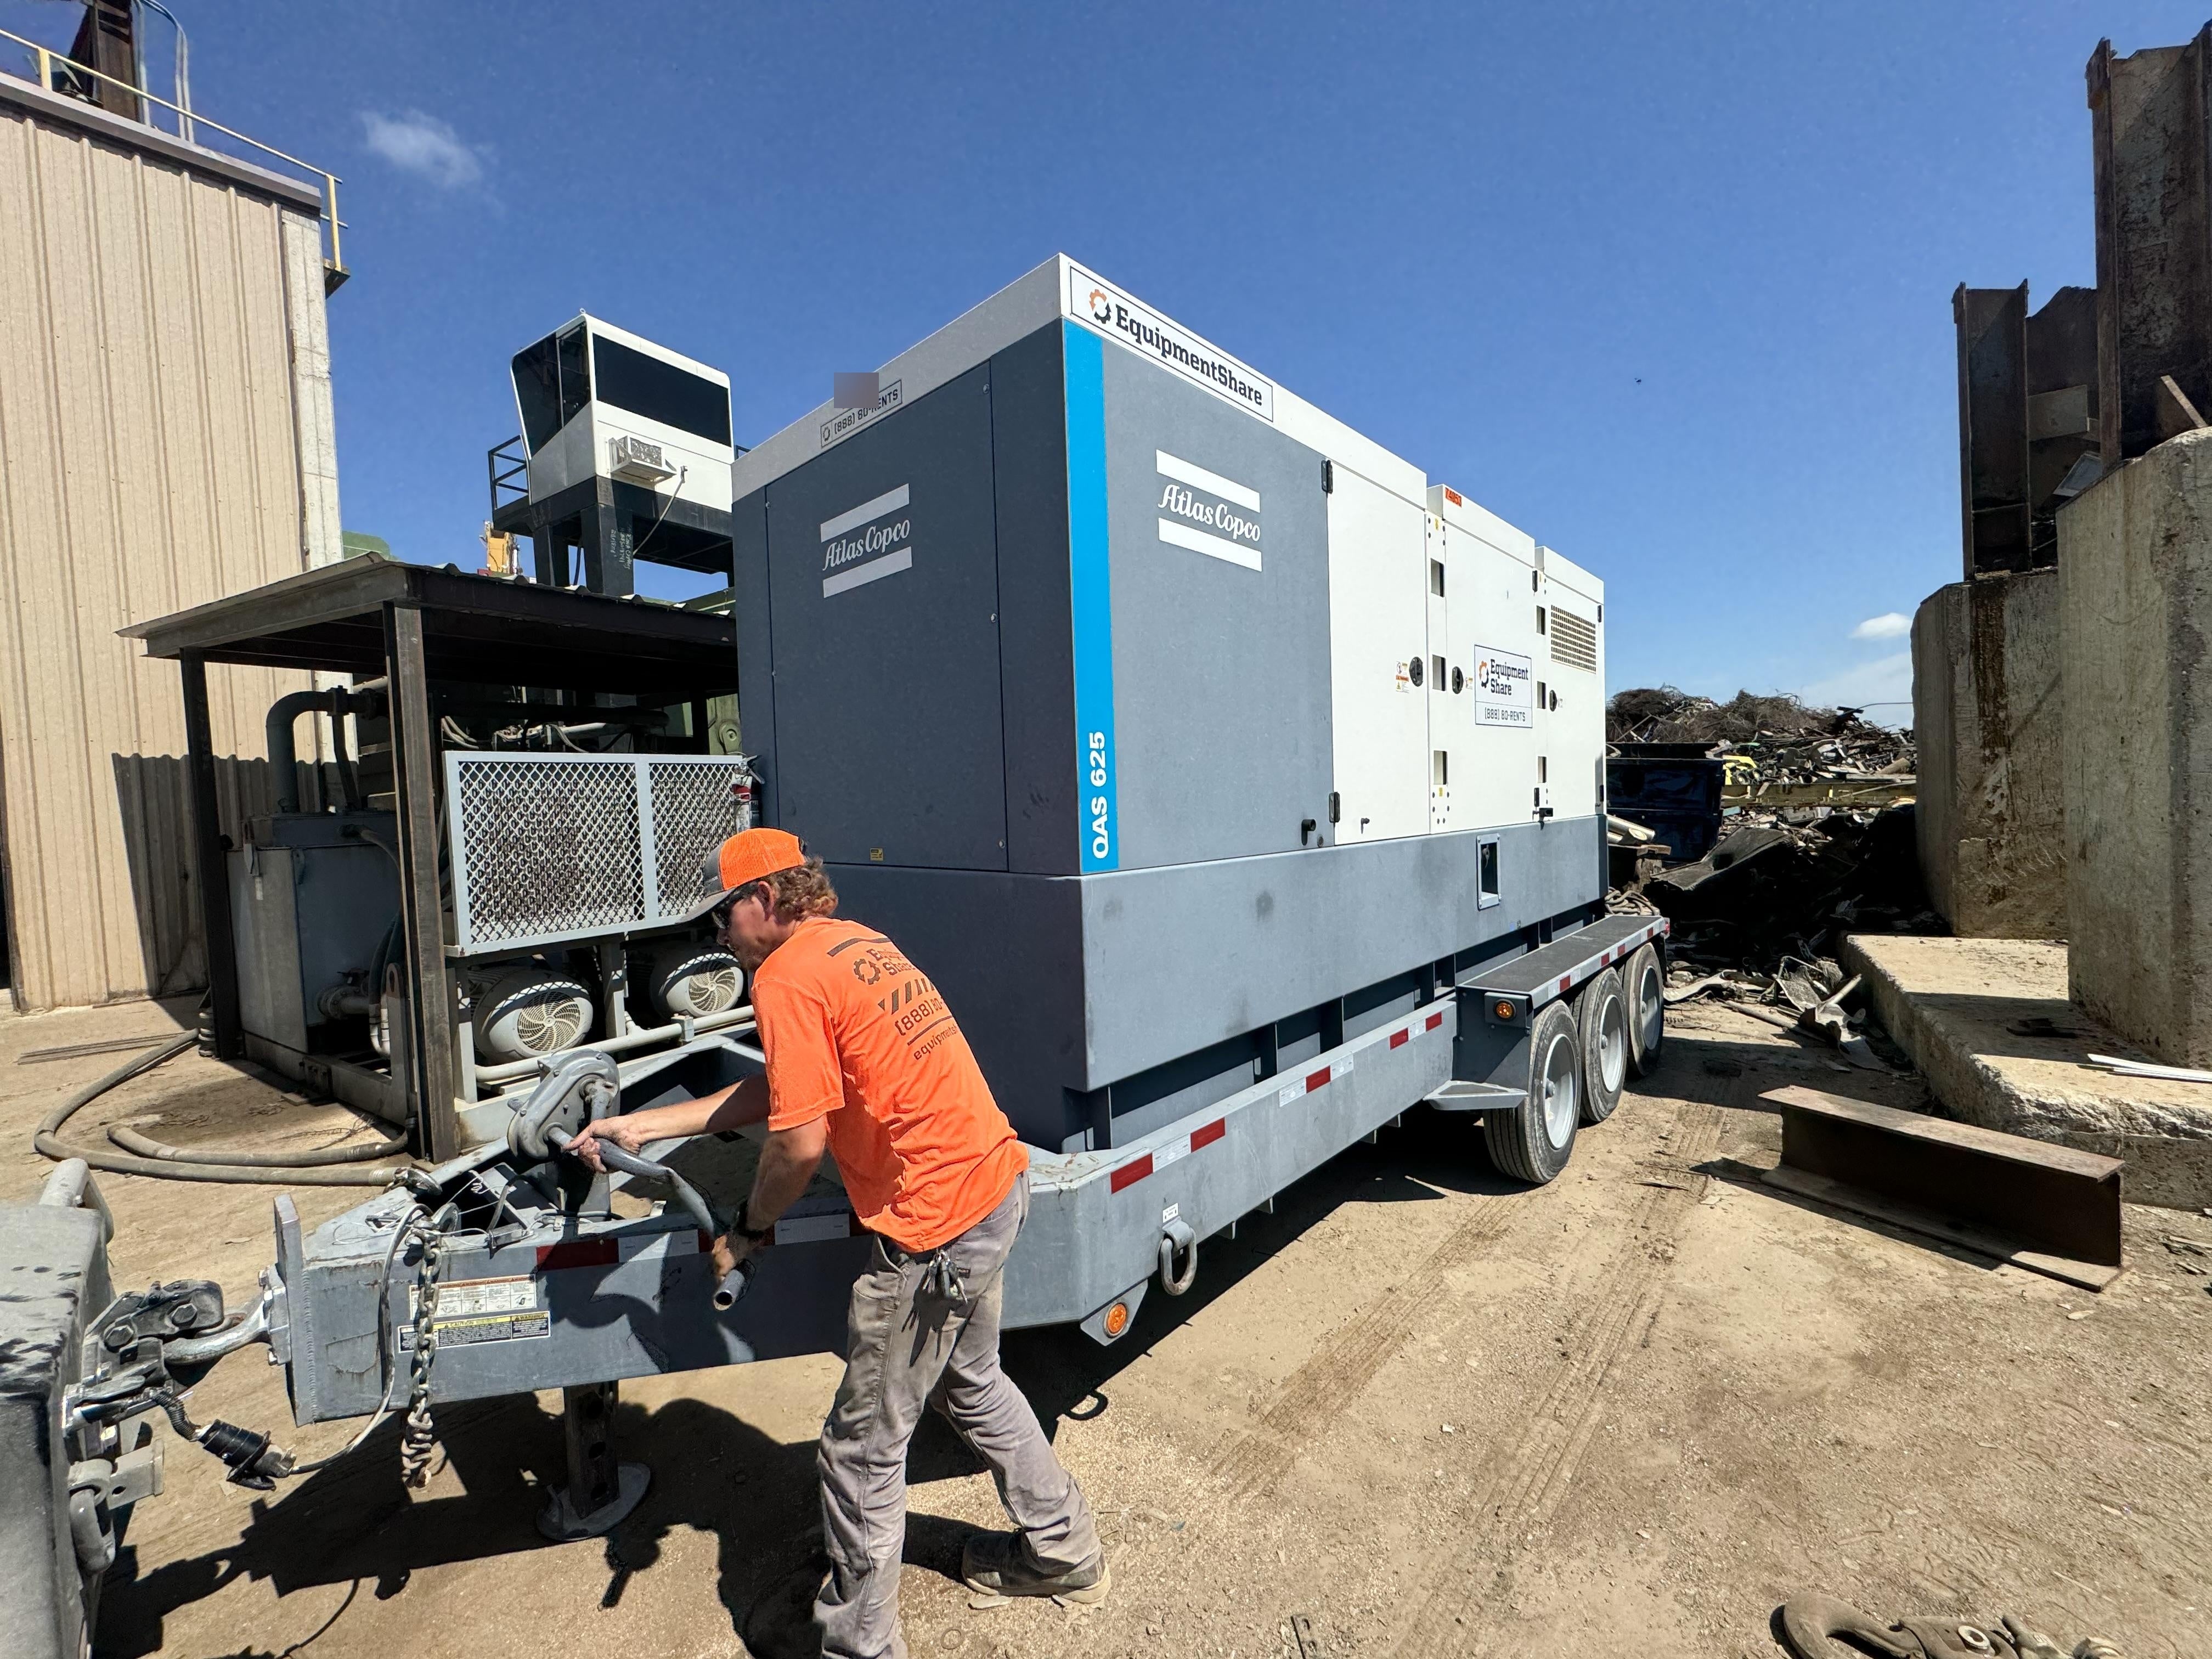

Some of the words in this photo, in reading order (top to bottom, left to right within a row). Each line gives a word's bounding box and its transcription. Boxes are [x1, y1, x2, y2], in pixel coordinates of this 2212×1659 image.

[1115, 303, 1262, 406] EquipmentShare
[834, 412, 855, 435] (888)
[1158, 484, 1214, 525] Atlas
[1215, 503, 1261, 541] Copco
[822, 539, 864, 571] Atlas
[865, 519, 910, 553] Copco
[1490, 658, 1528, 680] Equipment
[1491, 678, 1512, 696] Share
[1485, 707, 1500, 720] (888)
[1501, 709, 1526, 722] 80-RENTS
[1090, 731, 1107, 787] 625
[1091, 796, 1109, 859] QAS
[895, 1000, 934, 1036] (888)
[930, 997, 943, 1011] 80-
